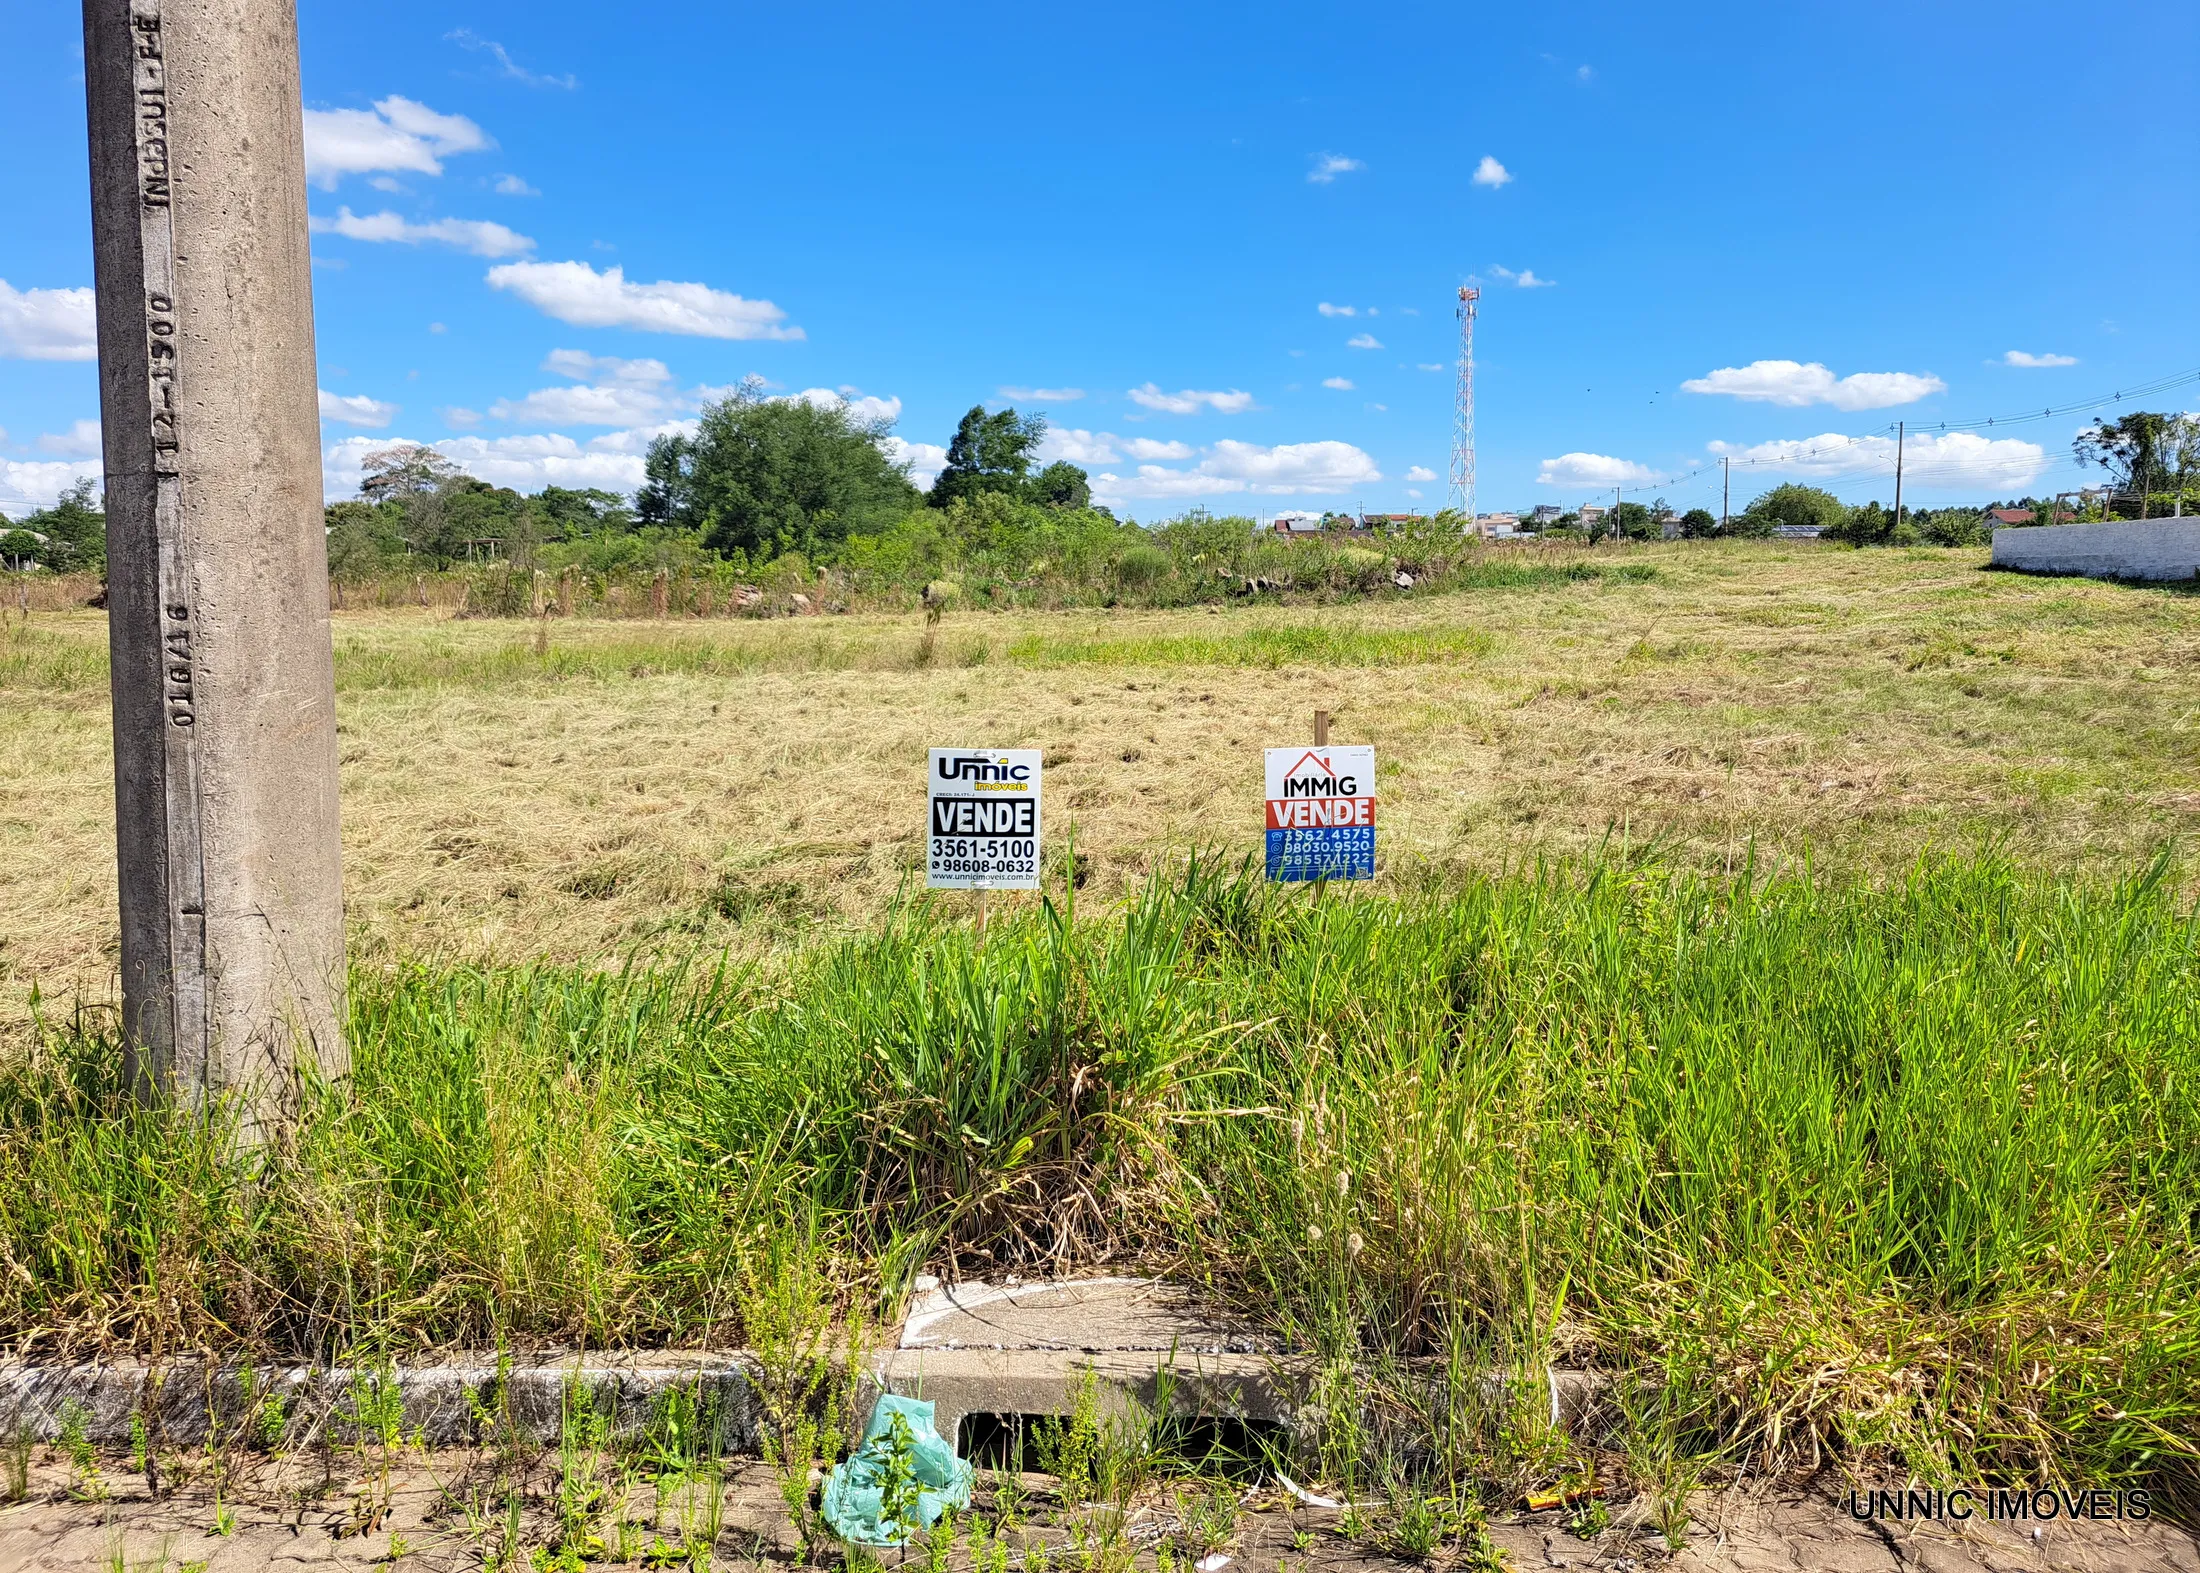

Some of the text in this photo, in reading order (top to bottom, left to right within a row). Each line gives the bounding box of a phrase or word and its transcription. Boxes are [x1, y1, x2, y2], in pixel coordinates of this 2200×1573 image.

[939, 757, 1030, 781] Unnic
[974, 781, 1029, 791] imóveis
[1284, 776, 1357, 797] IMMIG
[936, 801, 1032, 833] VENDE
[1272, 799, 1369, 827] VENDE
[1285, 828, 1370, 842] 3562.4575
[932, 839, 1034, 858] 3561-5100
[1285, 840, 1370, 854] 98030.9520
[943, 860, 1034, 873] 98608-0632
[932, 873, 1034, 881] www.unnicimoveis.com.br
